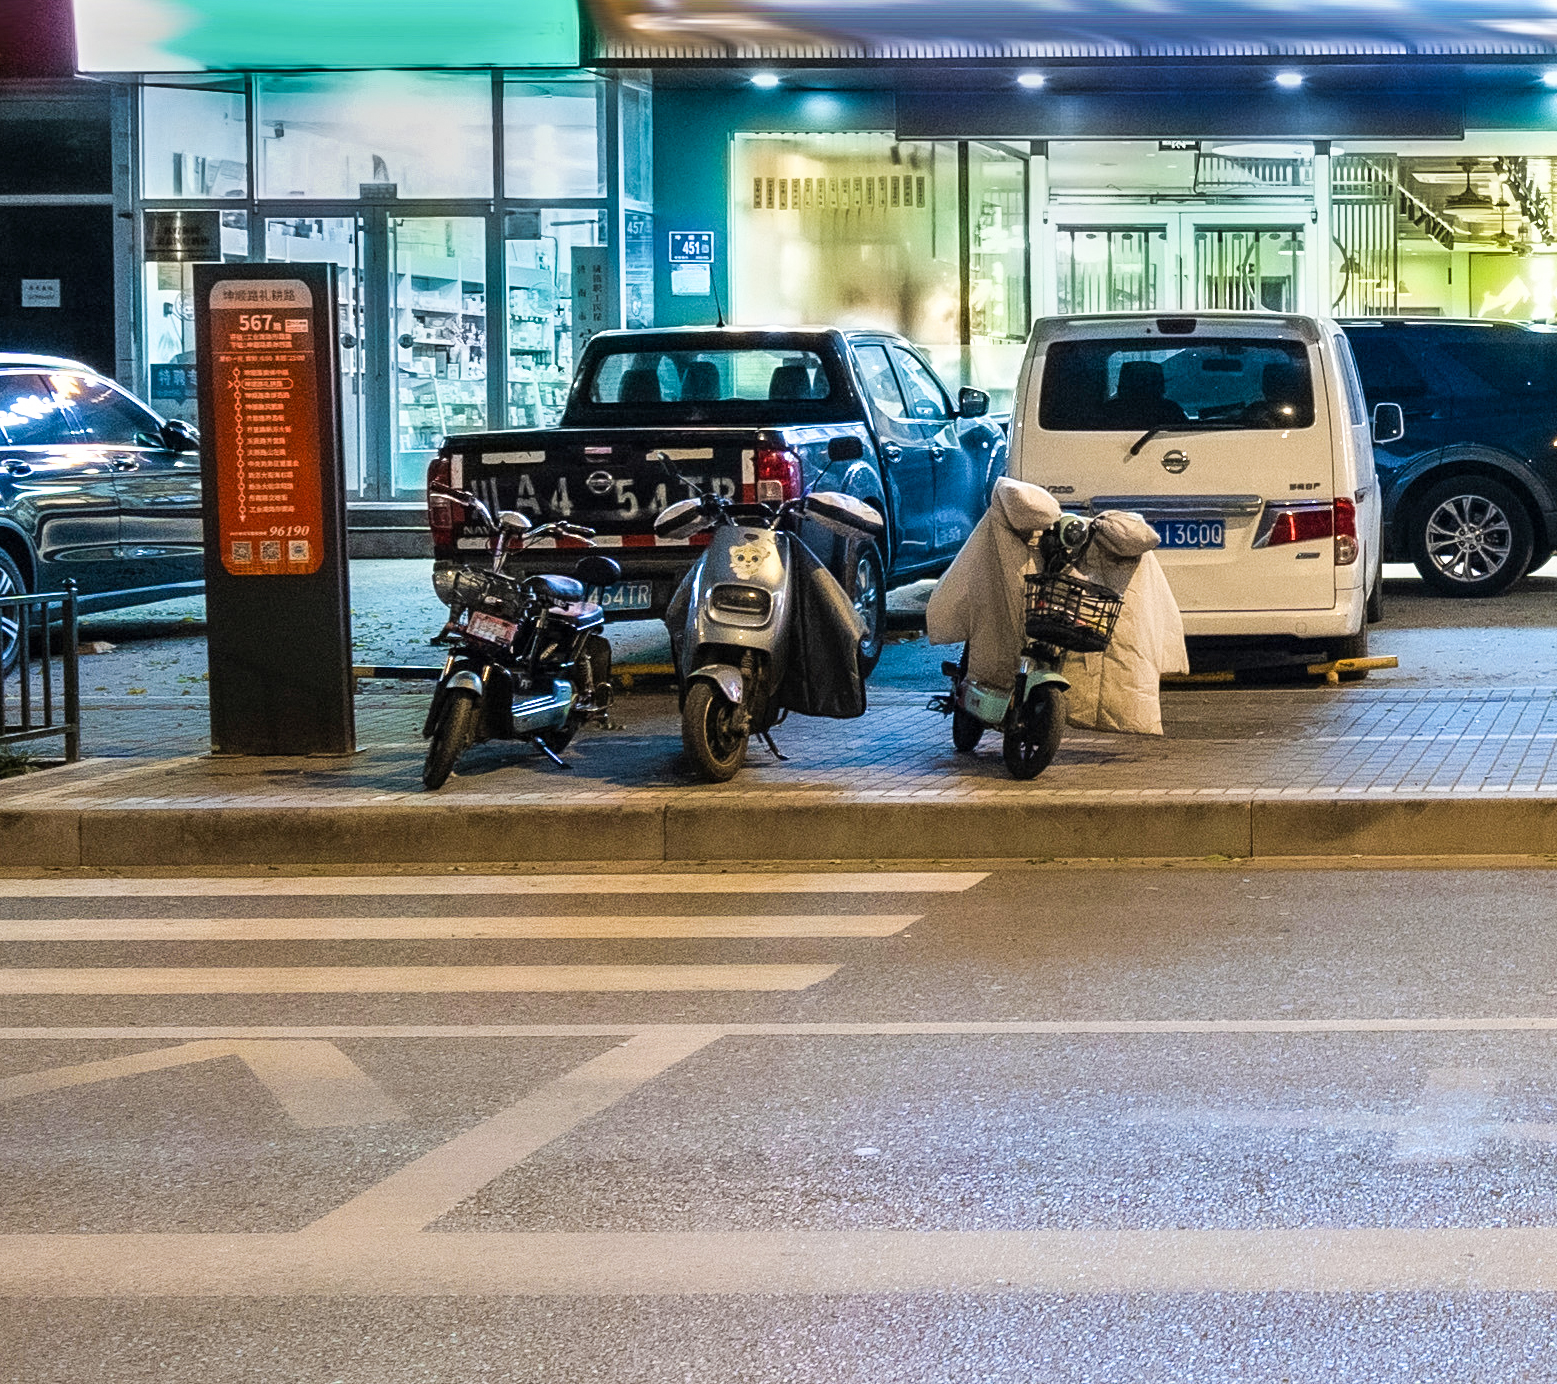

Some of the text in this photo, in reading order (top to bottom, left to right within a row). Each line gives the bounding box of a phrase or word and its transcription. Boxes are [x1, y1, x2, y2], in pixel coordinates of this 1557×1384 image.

[626, 221, 645, 235] 457
[682, 241, 700, 255] 451
[269, 525, 311, 537] 96190
